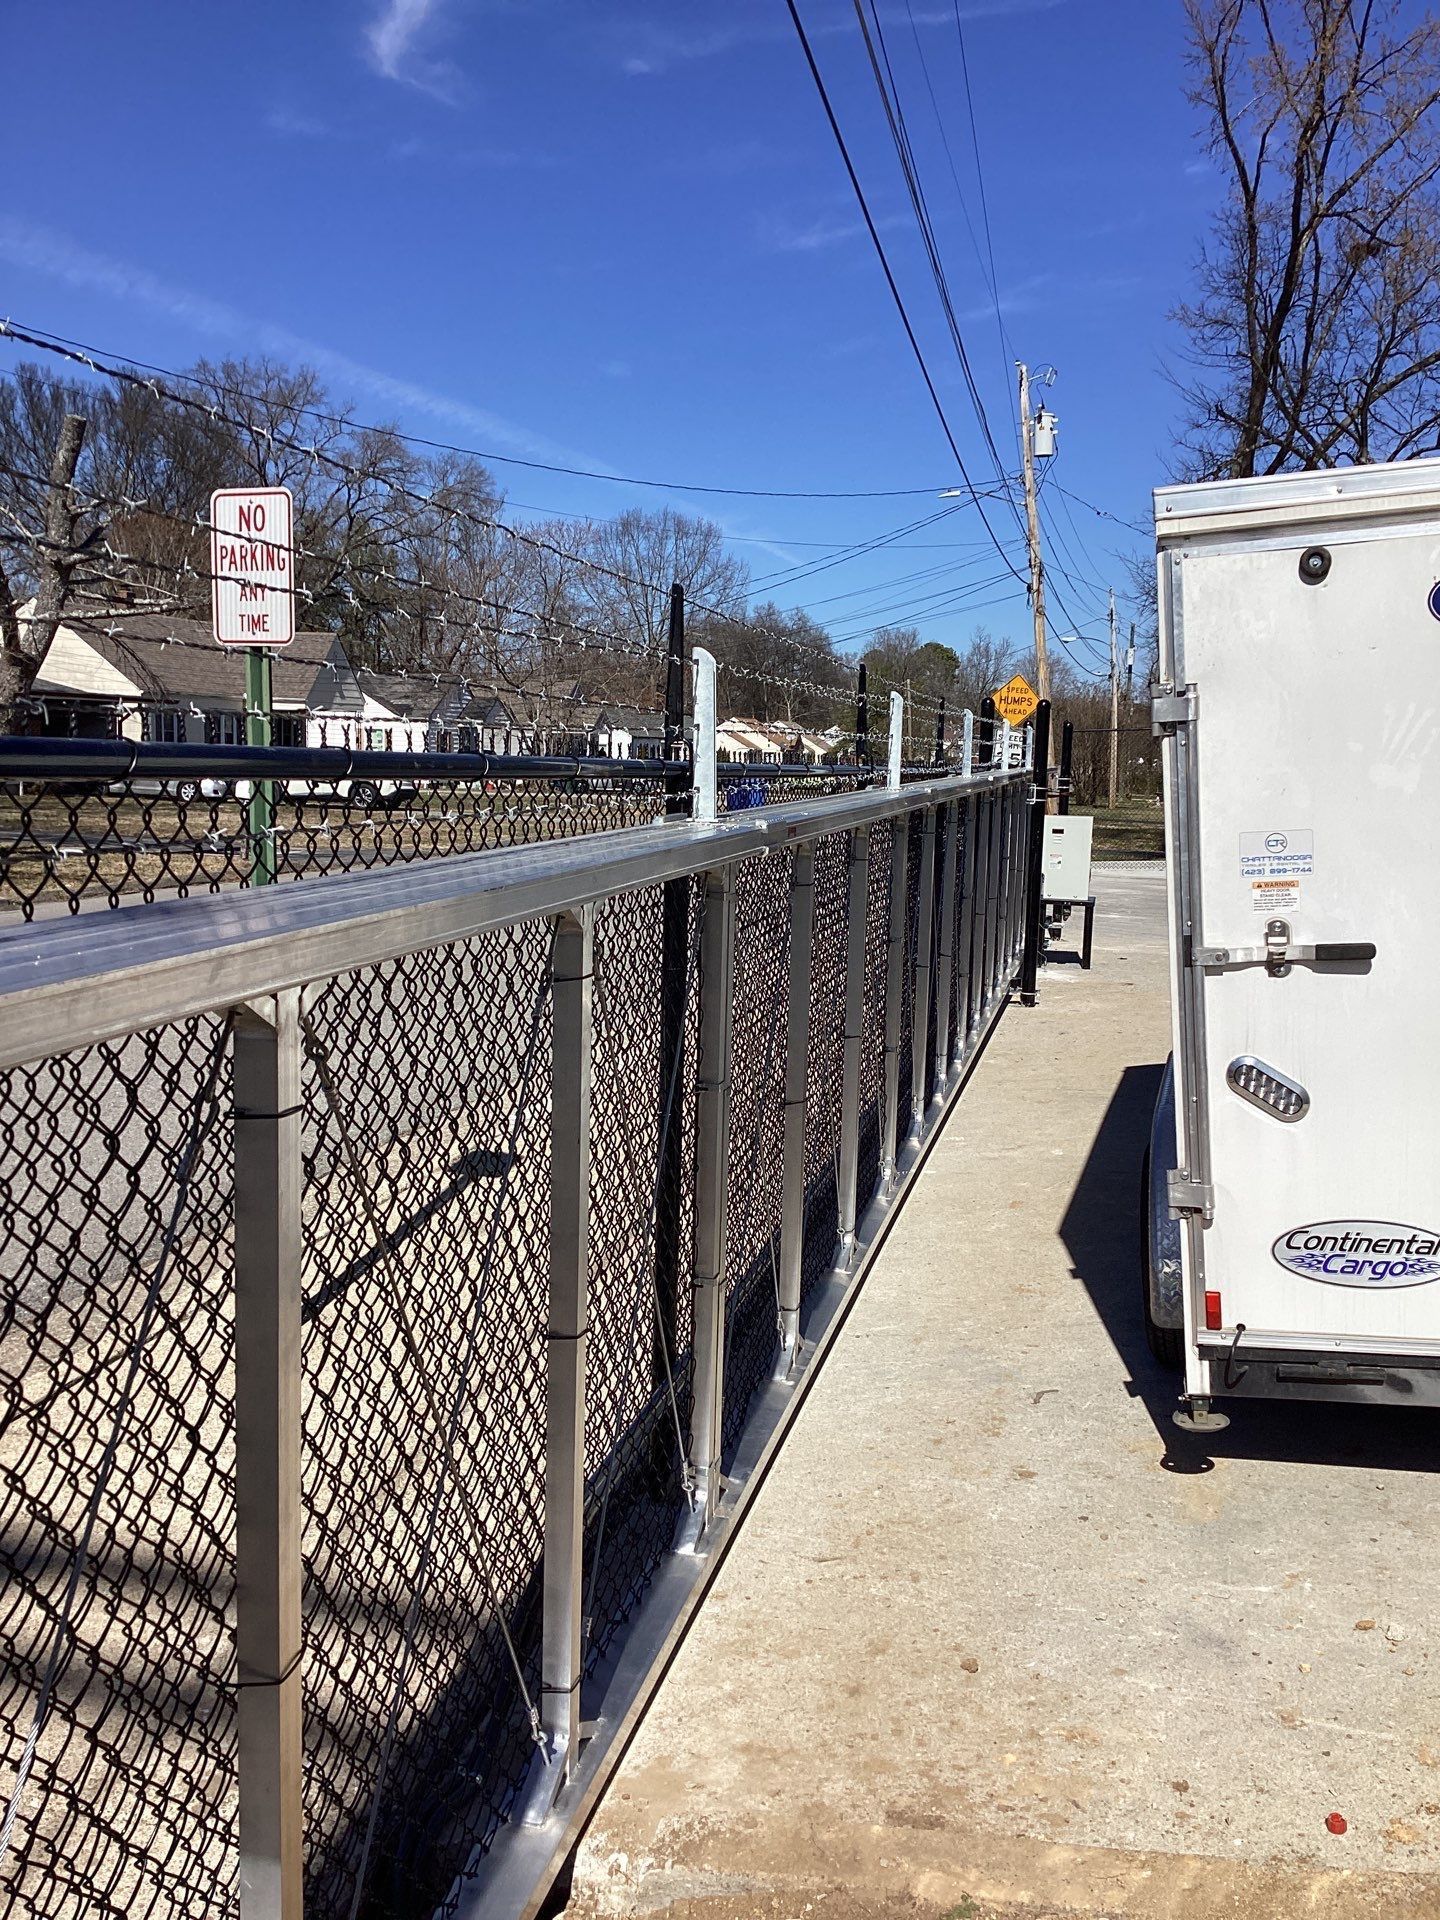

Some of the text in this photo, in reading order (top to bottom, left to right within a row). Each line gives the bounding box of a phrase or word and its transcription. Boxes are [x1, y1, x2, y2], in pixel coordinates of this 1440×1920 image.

[238, 504, 266, 532] NO
[219, 544, 286, 572] PARKING
[239, 583, 268, 602] ANY
[239, 614, 270, 632] TIME
[999, 696, 1033, 707] HUMPS
[1003, 708, 1028, 716] AHEAD
[998, 733, 1023, 742] SEED
[1240, 854, 1313, 863] CHATTANOOGA
[1241, 867, 1312, 876] (423) 899-1744
[1285, 1230, 1440, 1256] Continental
[1322, 1253, 1409, 1281] Cargo
